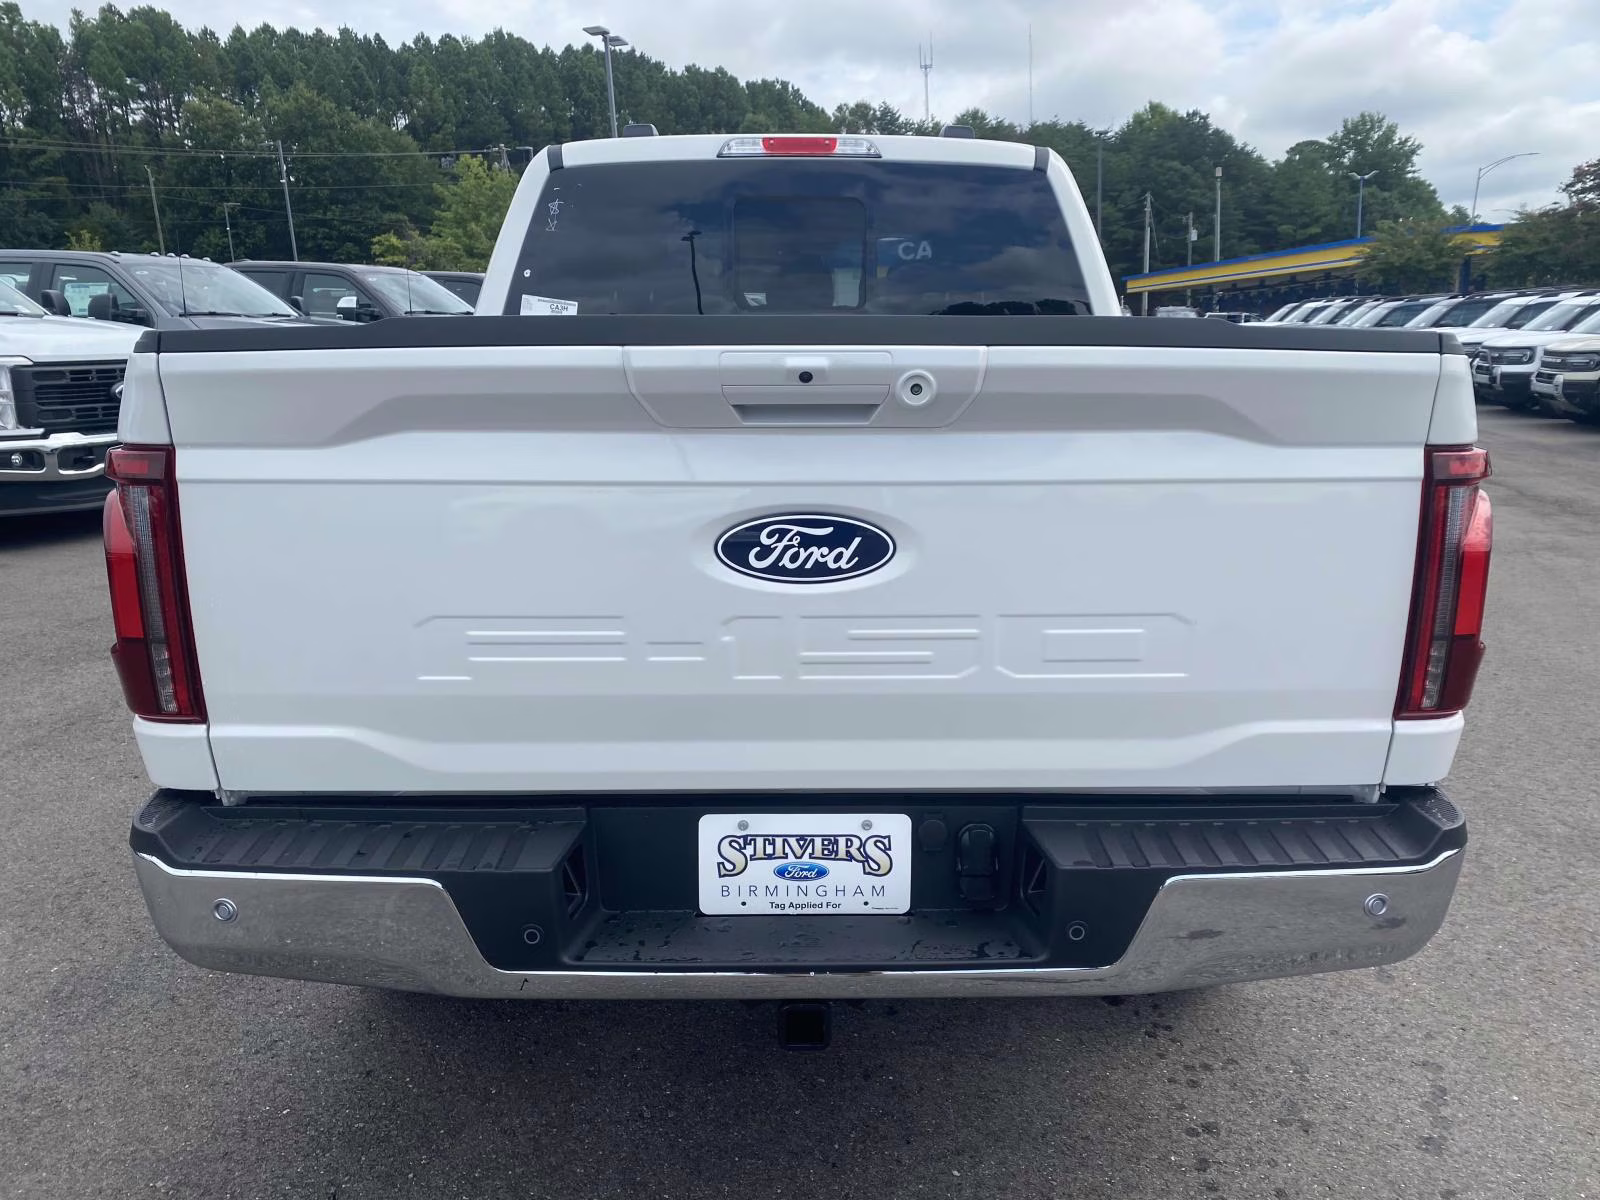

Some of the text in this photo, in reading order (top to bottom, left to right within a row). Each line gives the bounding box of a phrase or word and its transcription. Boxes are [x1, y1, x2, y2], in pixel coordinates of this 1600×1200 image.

[748, 524, 862, 569] Ford
[412, 614, 1195, 682] F-150
[717, 834, 893, 878] STIVERS
[784, 864, 818, 878] Ford
[721, 884, 886, 897] BIRMINGHAM
[769, 901, 842, 910] Tag Applied For
